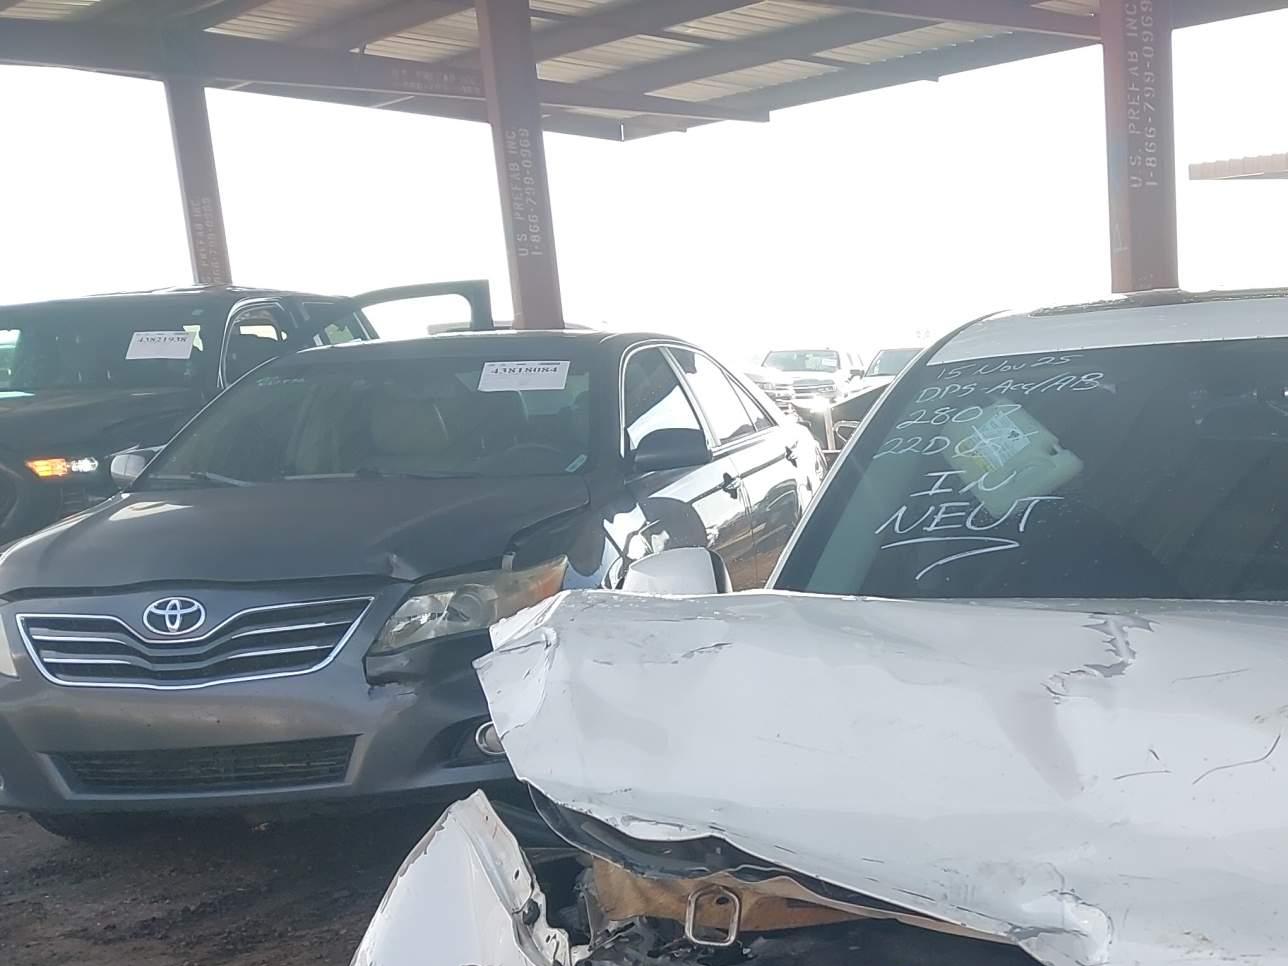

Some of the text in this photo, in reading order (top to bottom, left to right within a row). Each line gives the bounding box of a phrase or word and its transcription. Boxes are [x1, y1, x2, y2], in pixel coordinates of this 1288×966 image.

[1126, 51, 1141, 135] PREFAB
[937, 364, 977, 380] 15
[1031, 354, 1085, 368] 25
[909, 470, 1017, 497] IN
[874, 496, 1065, 535] NEUT
